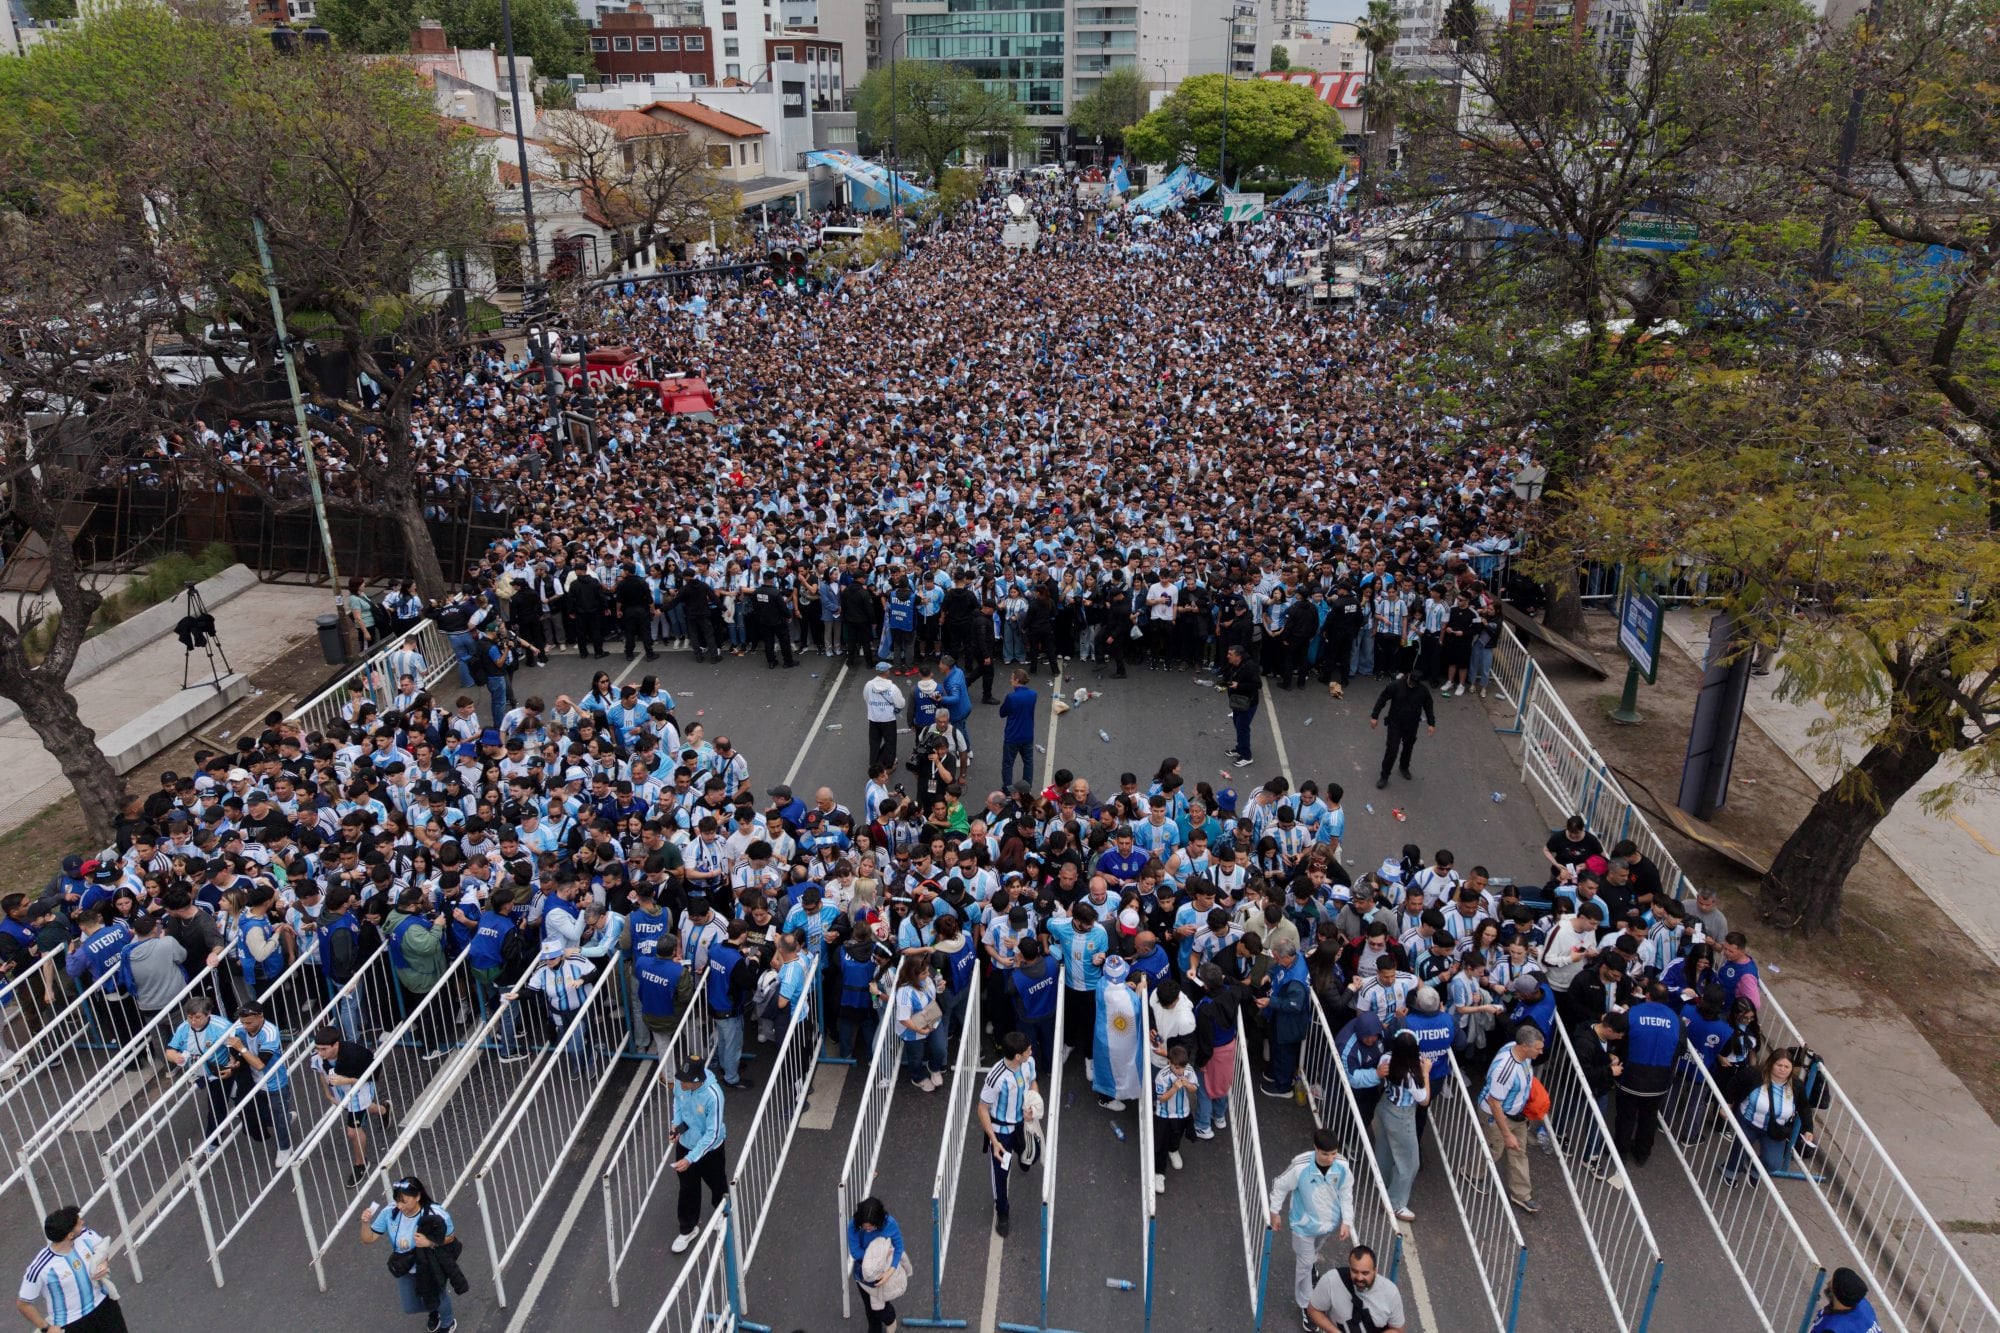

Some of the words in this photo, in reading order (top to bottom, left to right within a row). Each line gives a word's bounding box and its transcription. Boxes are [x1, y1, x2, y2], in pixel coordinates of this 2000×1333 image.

[635, 923, 664, 933] UTEDYC
[88, 929, 124, 954] UTEDYC
[641, 970, 669, 987] UTEDYC
[1028, 977, 1054, 995] UTEDYC
[1640, 1016, 1671, 1029] UTEDYC
[1416, 1027, 1450, 1041] UTEDYC
